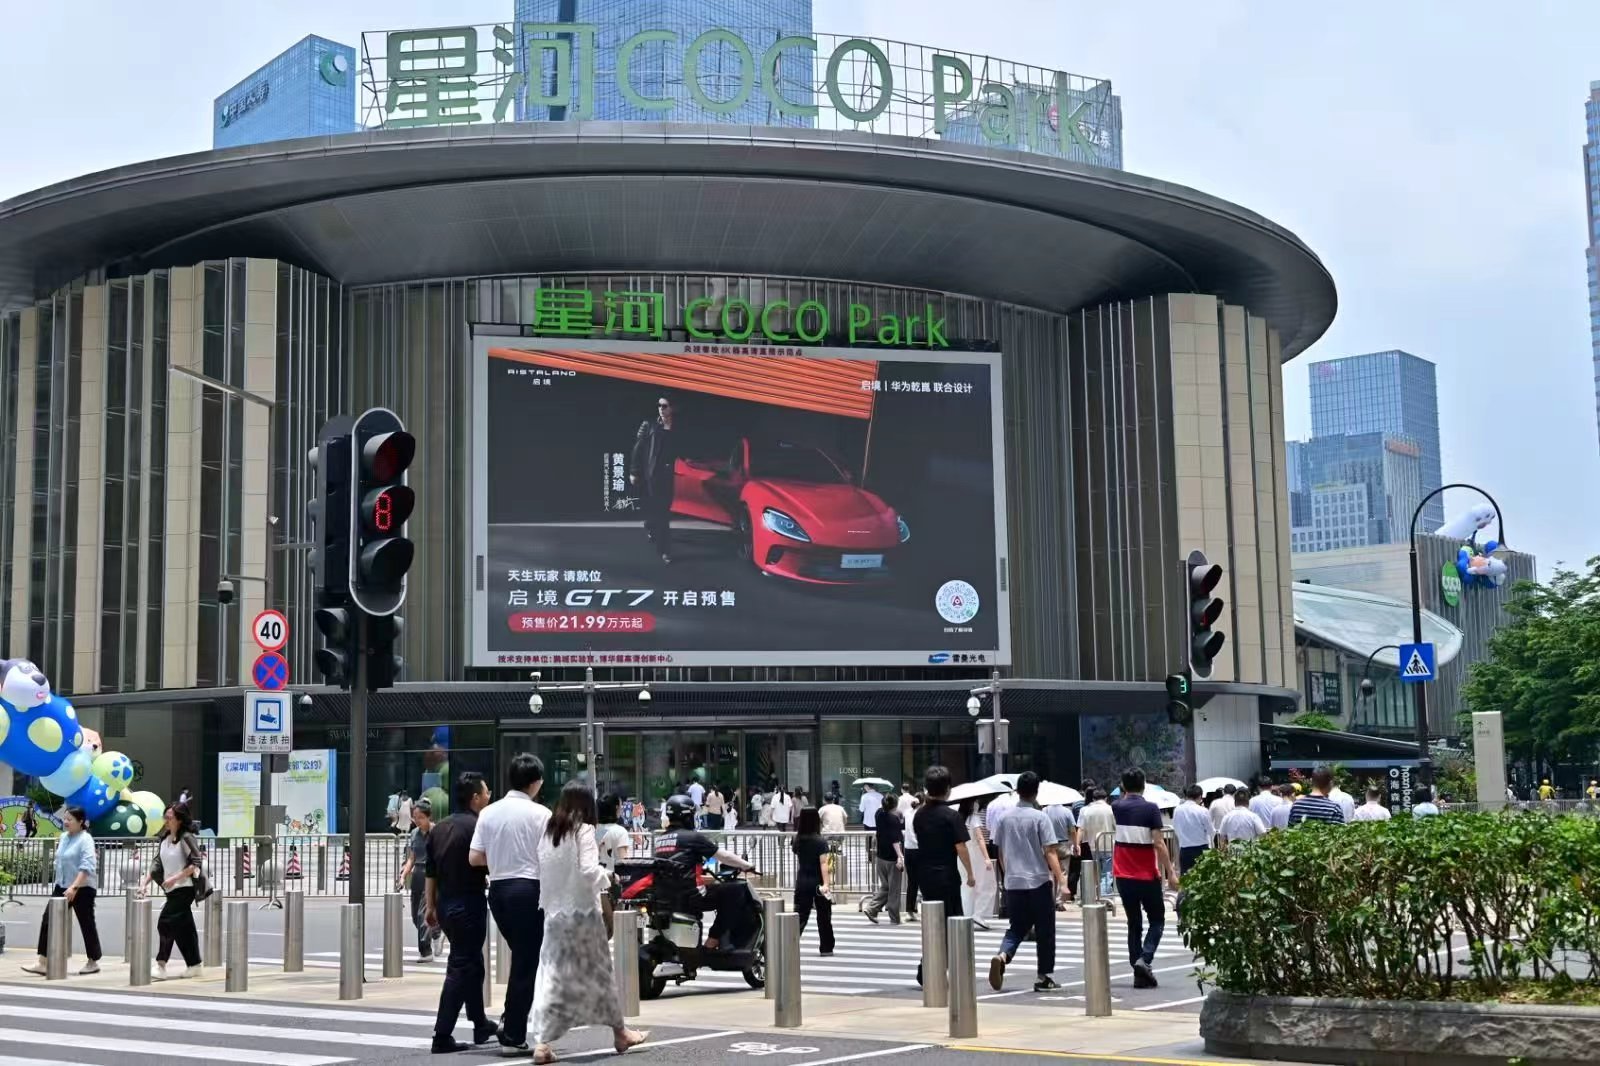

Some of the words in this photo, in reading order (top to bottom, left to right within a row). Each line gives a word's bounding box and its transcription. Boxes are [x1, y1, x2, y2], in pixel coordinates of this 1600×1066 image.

[384, 22, 597, 129] 星河
[616, 27, 894, 123] COCO
[931, 53, 1098, 160] Park
[534, 287, 664, 336] 星河
[684, 298, 828, 341] COCO
[848, 303, 947, 347] Park
[861, 380, 881, 391] 启境
[933, 382, 973, 394] 联合设计
[612, 452, 625, 492] 黄景瑜
[508, 570, 559, 582] 天生玩家
[563, 570, 601, 582] 请就位
[508, 590, 558, 606] 启境
[564, 589, 654, 606] GT7
[663, 590, 736, 606] 开启预售
[260, 621, 281, 640] 40
[521, 616, 643, 629] 预售价21.99万元起
[952, 653, 986, 664] 雷曼光电
[1179, 677, 1187, 694] 3
[247, 734, 290, 745] 违法抓拍
